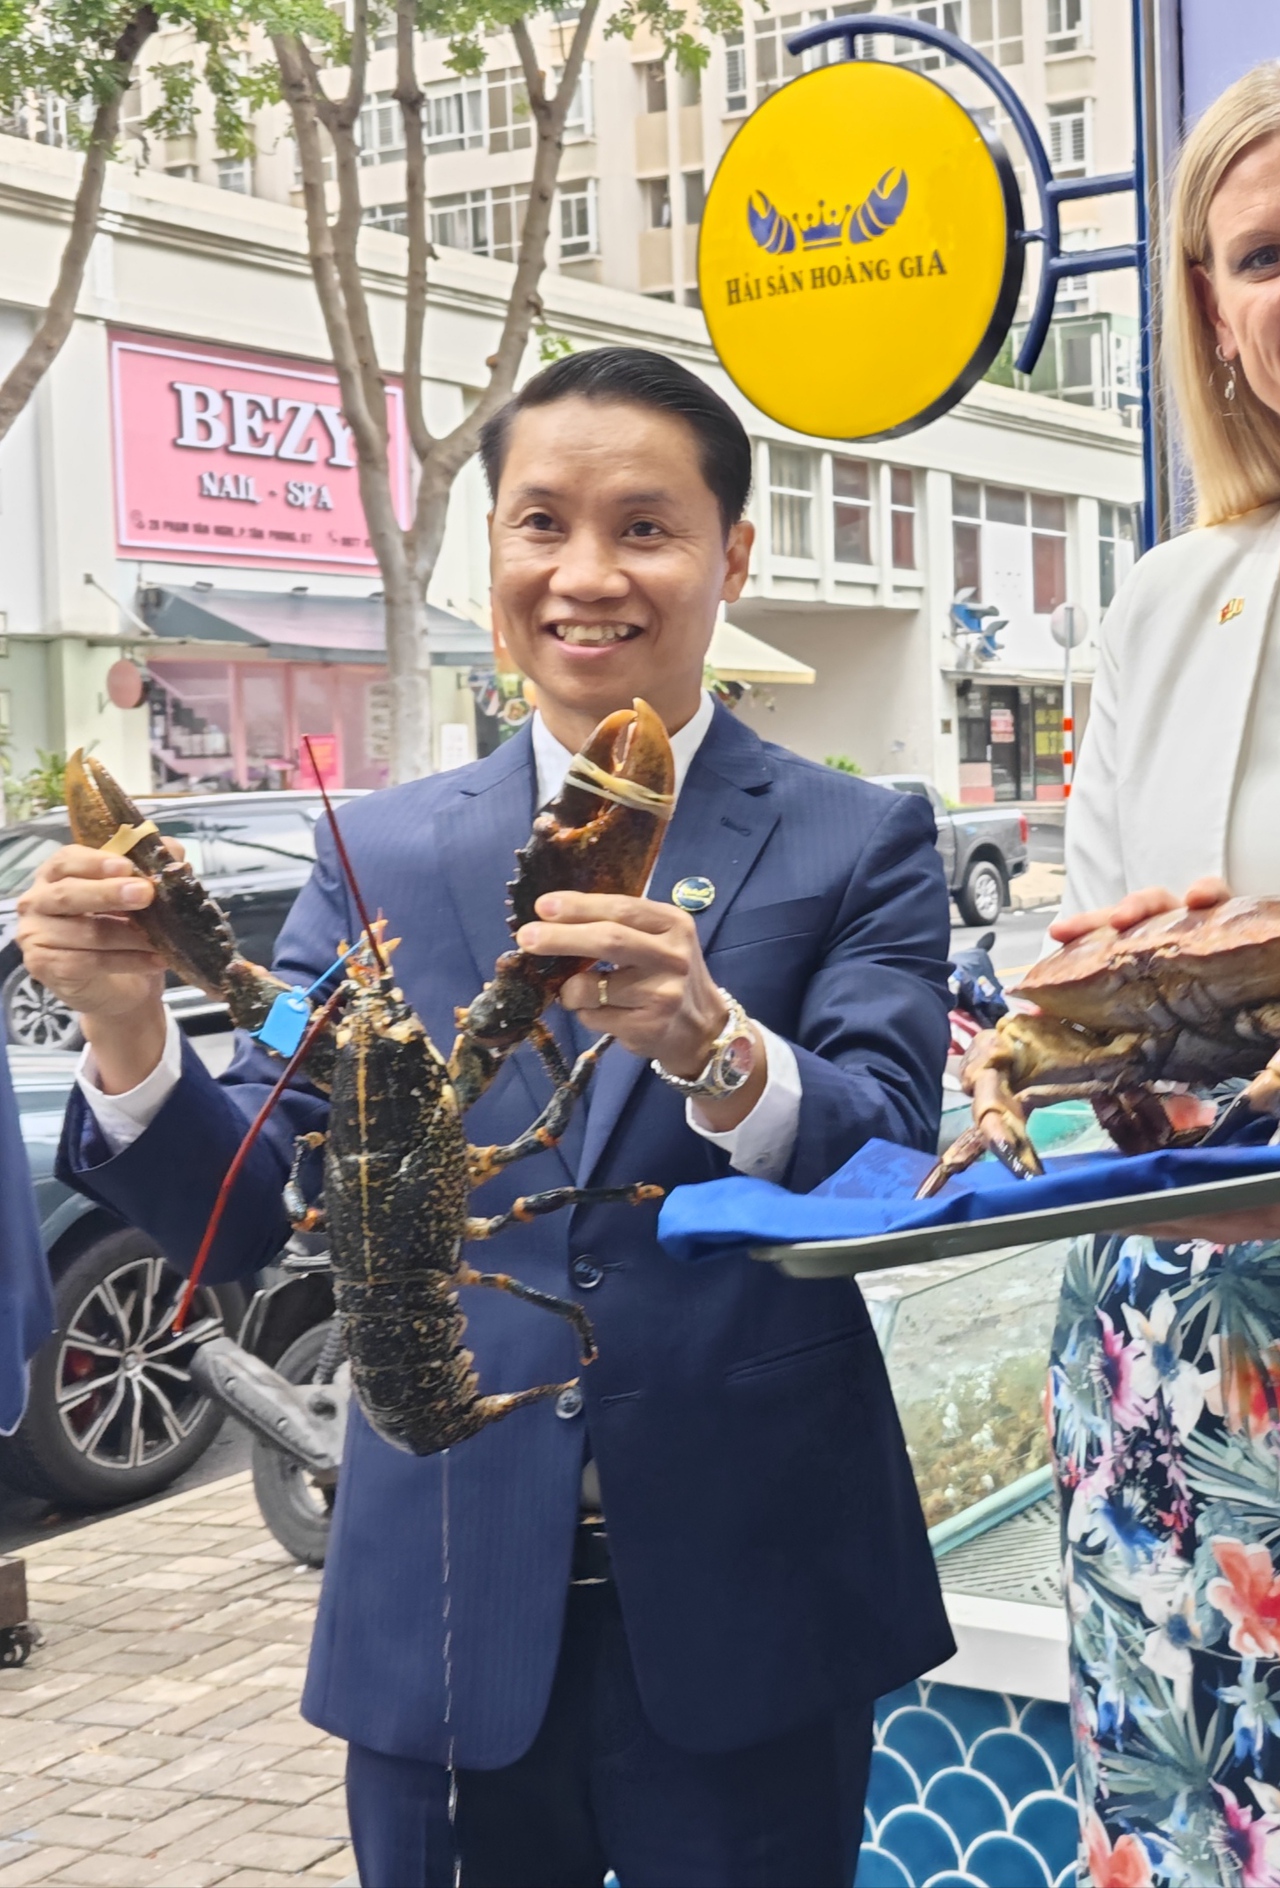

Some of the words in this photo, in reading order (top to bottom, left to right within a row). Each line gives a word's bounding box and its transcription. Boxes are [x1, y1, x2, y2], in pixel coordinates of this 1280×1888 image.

[810, 256, 891, 290] HOÀNG
[899, 249, 948, 279] GIA
[170, 381, 356, 469] BEZY
[200, 471, 262, 504] NAIL
[285, 479, 335, 510] SPA
